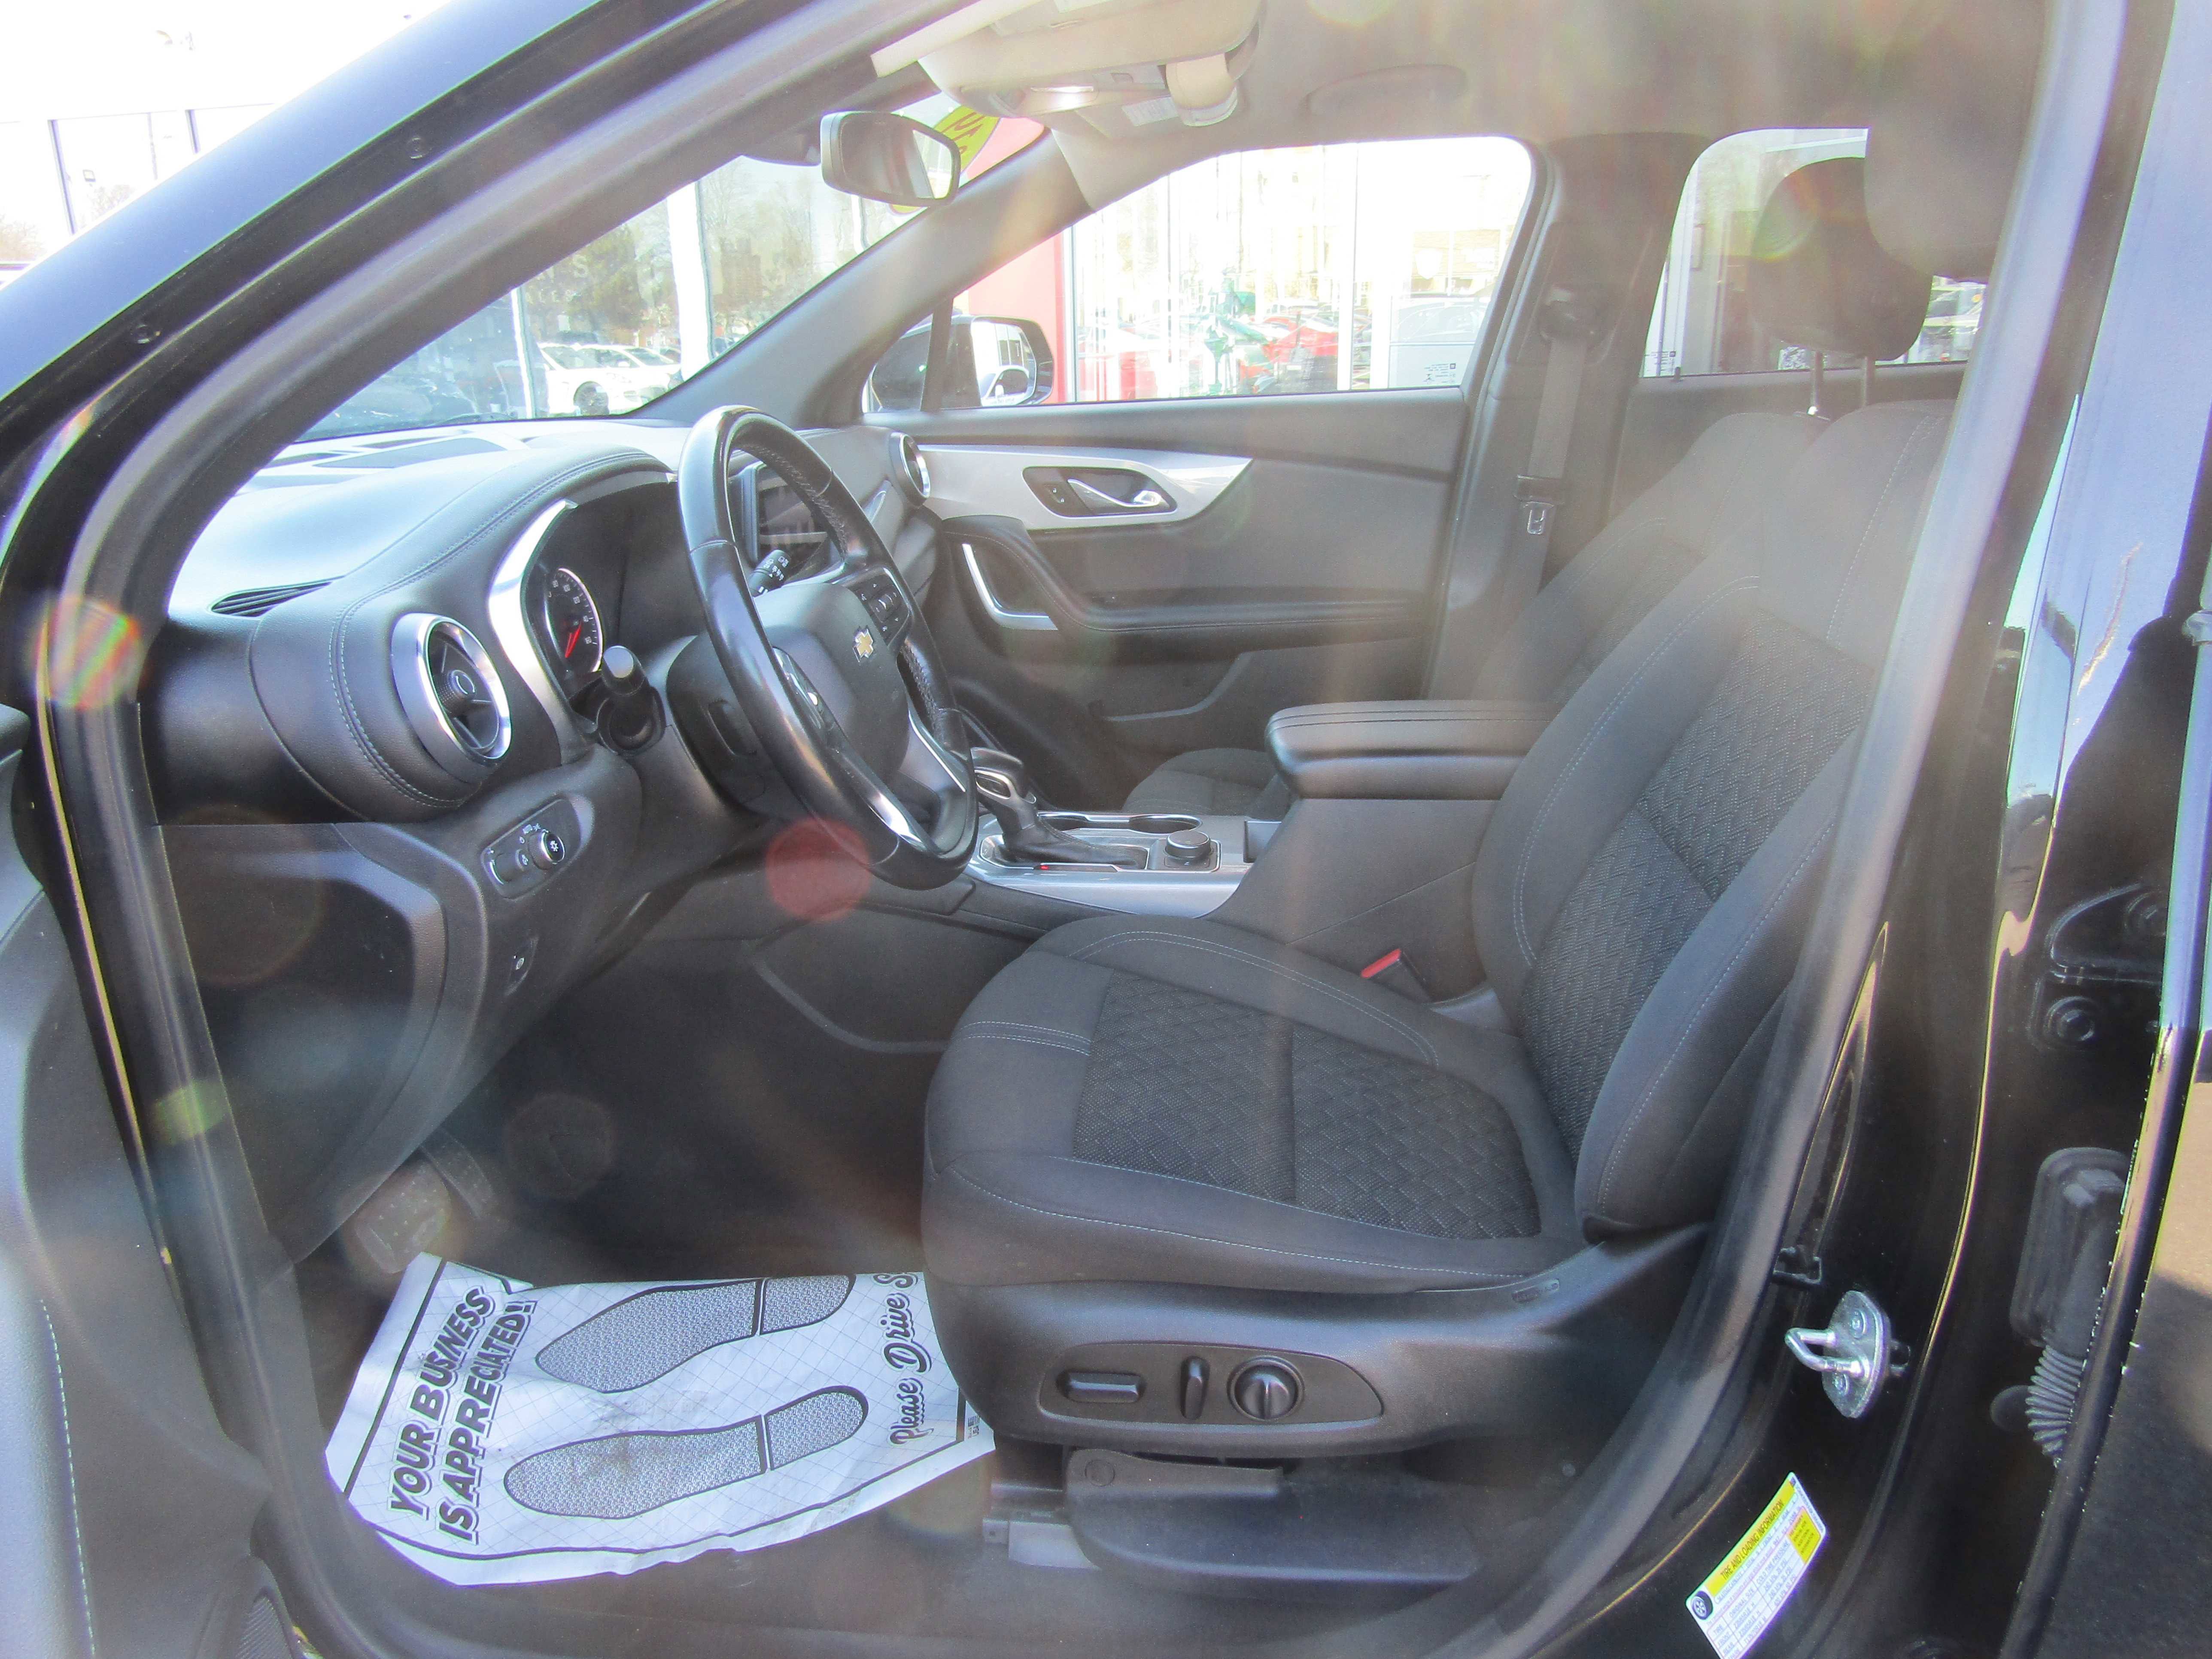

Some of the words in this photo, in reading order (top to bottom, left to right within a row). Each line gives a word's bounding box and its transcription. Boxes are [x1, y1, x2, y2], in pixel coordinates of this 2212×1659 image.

[409, 1286, 495, 1425] BUSINESS
[879, 1293, 932, 1373] Drive
[441, 1302, 537, 1507] APPRECIATED!
[888, 1377, 934, 1445] Please
[389, 1422, 440, 1520] YOUR
[437, 1498, 480, 1544] IS
[1720, 1563, 1733, 1582] TIRE
[1729, 1553, 1743, 1571] AND
[1738, 1531, 1760, 1560] LOADING
[1756, 1498, 1785, 1538] INFORMATION
